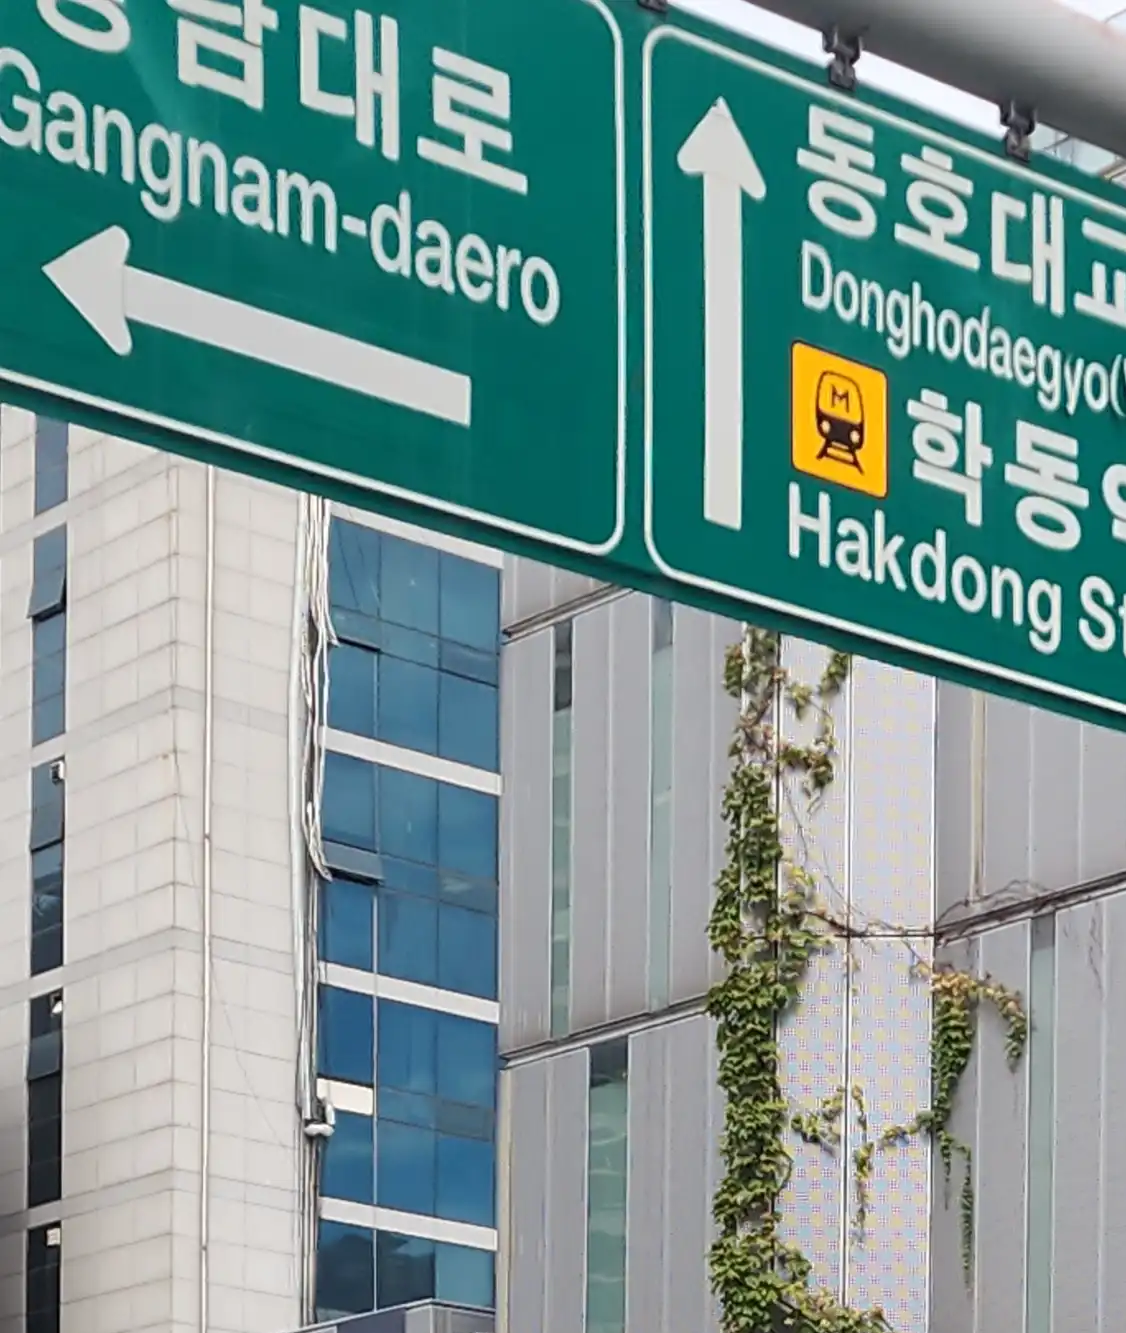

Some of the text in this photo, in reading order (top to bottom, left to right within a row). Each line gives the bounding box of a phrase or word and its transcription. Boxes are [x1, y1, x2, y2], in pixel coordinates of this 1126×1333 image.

[0, 47, 561, 325] Gangnam-daero
[35, 0, 528, 195] 남대로
[788, 484, 1063, 654] Hakdong
